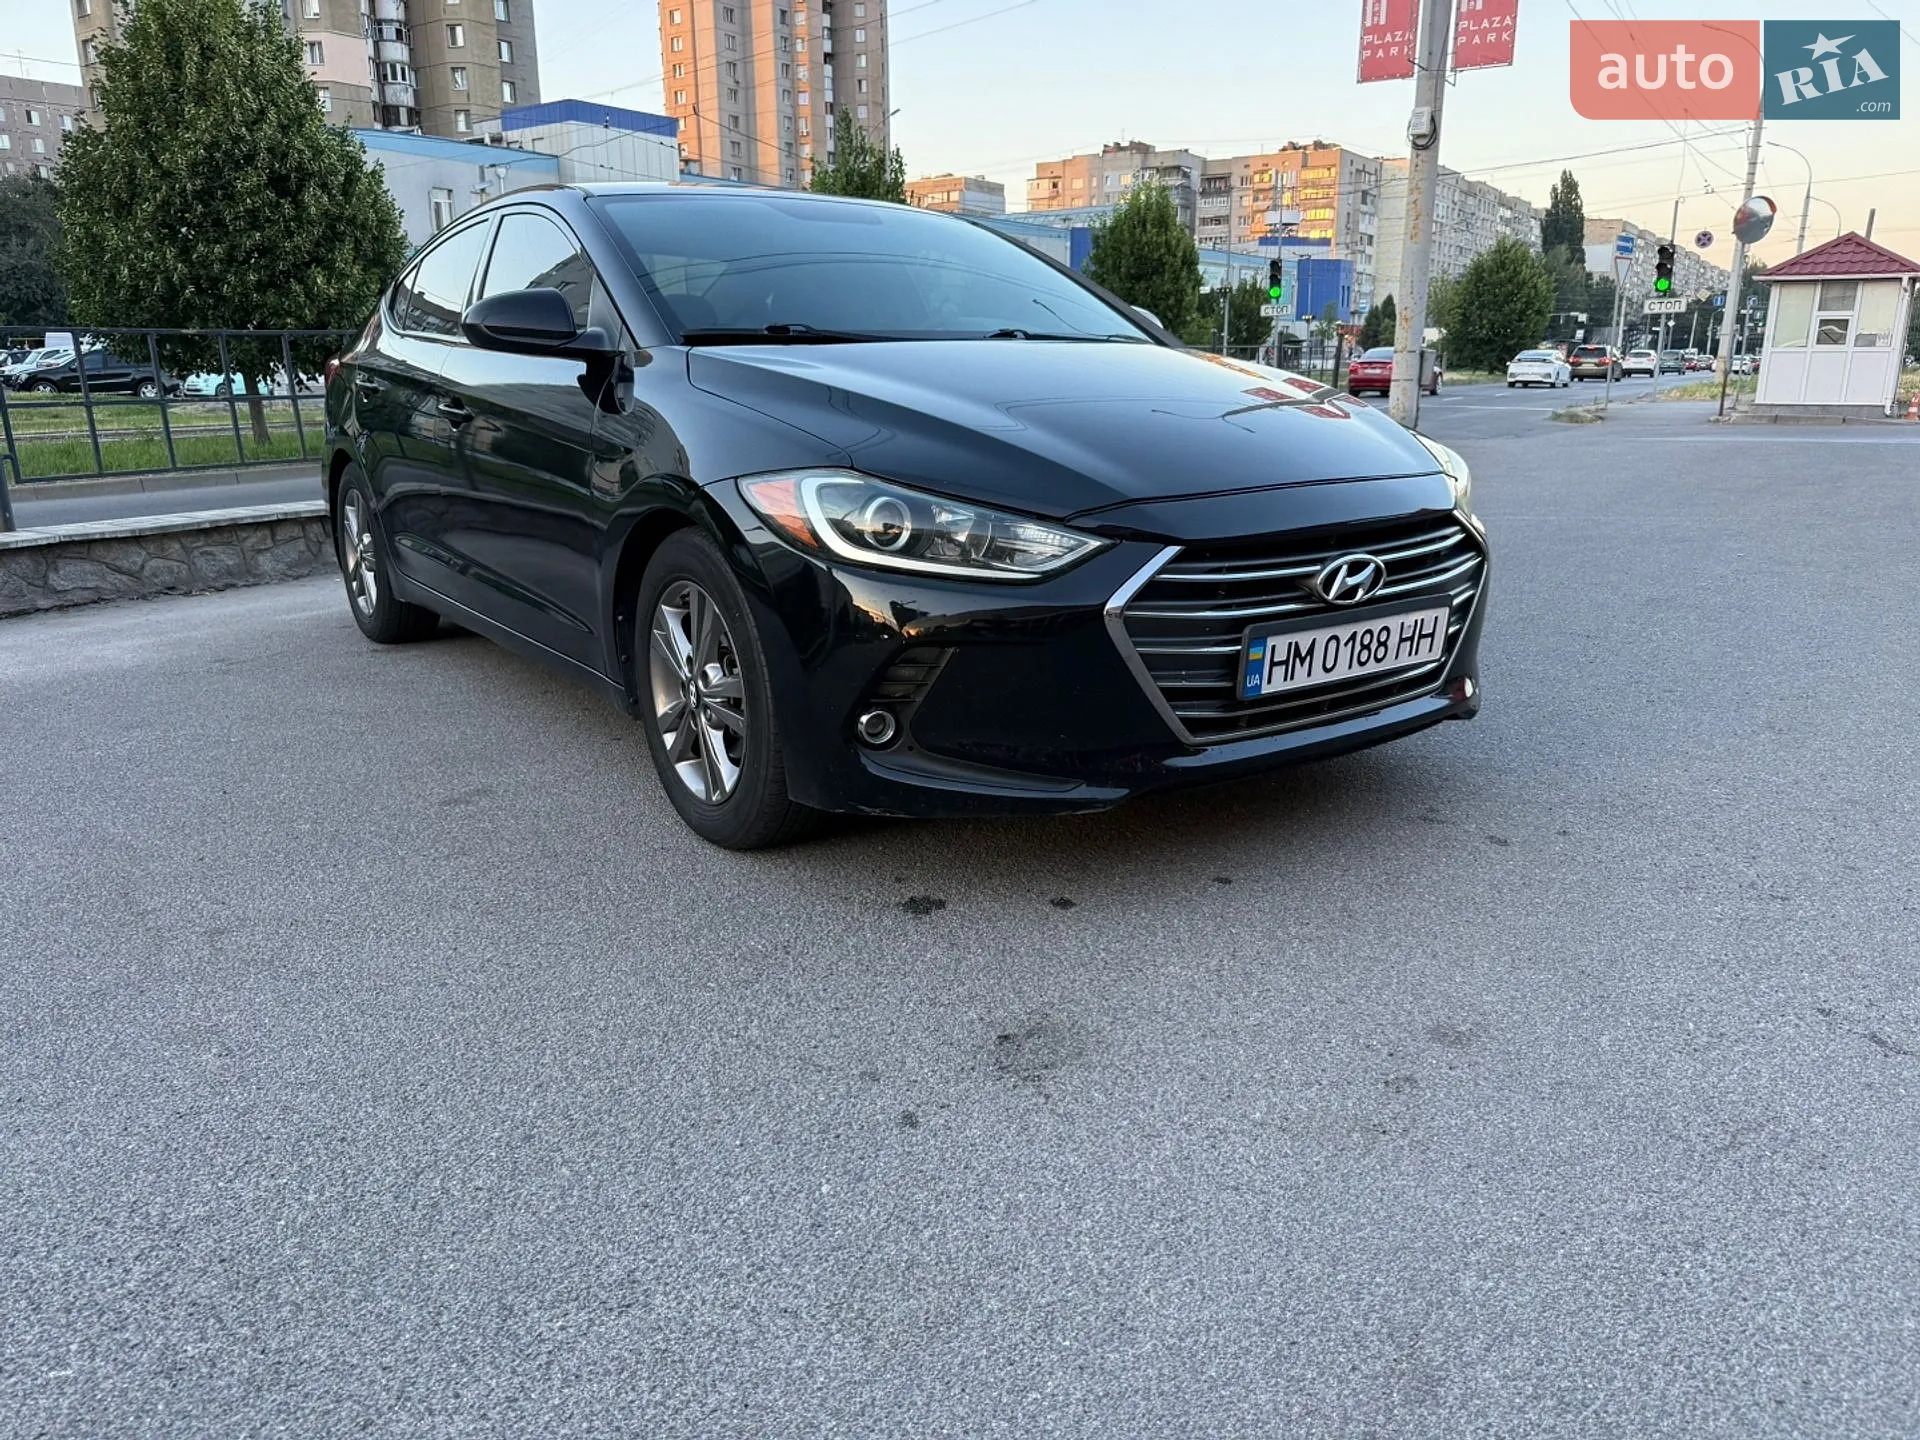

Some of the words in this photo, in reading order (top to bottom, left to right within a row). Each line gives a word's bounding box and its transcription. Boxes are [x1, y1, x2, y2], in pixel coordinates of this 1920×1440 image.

[1458, 16, 1512, 32] PLAZA
[1363, 30, 1414, 46] PLAZA
[1457, 30, 1512, 46] PARK
[1648, 300, 1682, 311] СТОП
[1266, 637, 1316, 685] HM
[1321, 625, 1391, 674] 0188
[1395, 615, 1439, 660] HH
[1246, 673, 1261, 687] UA
